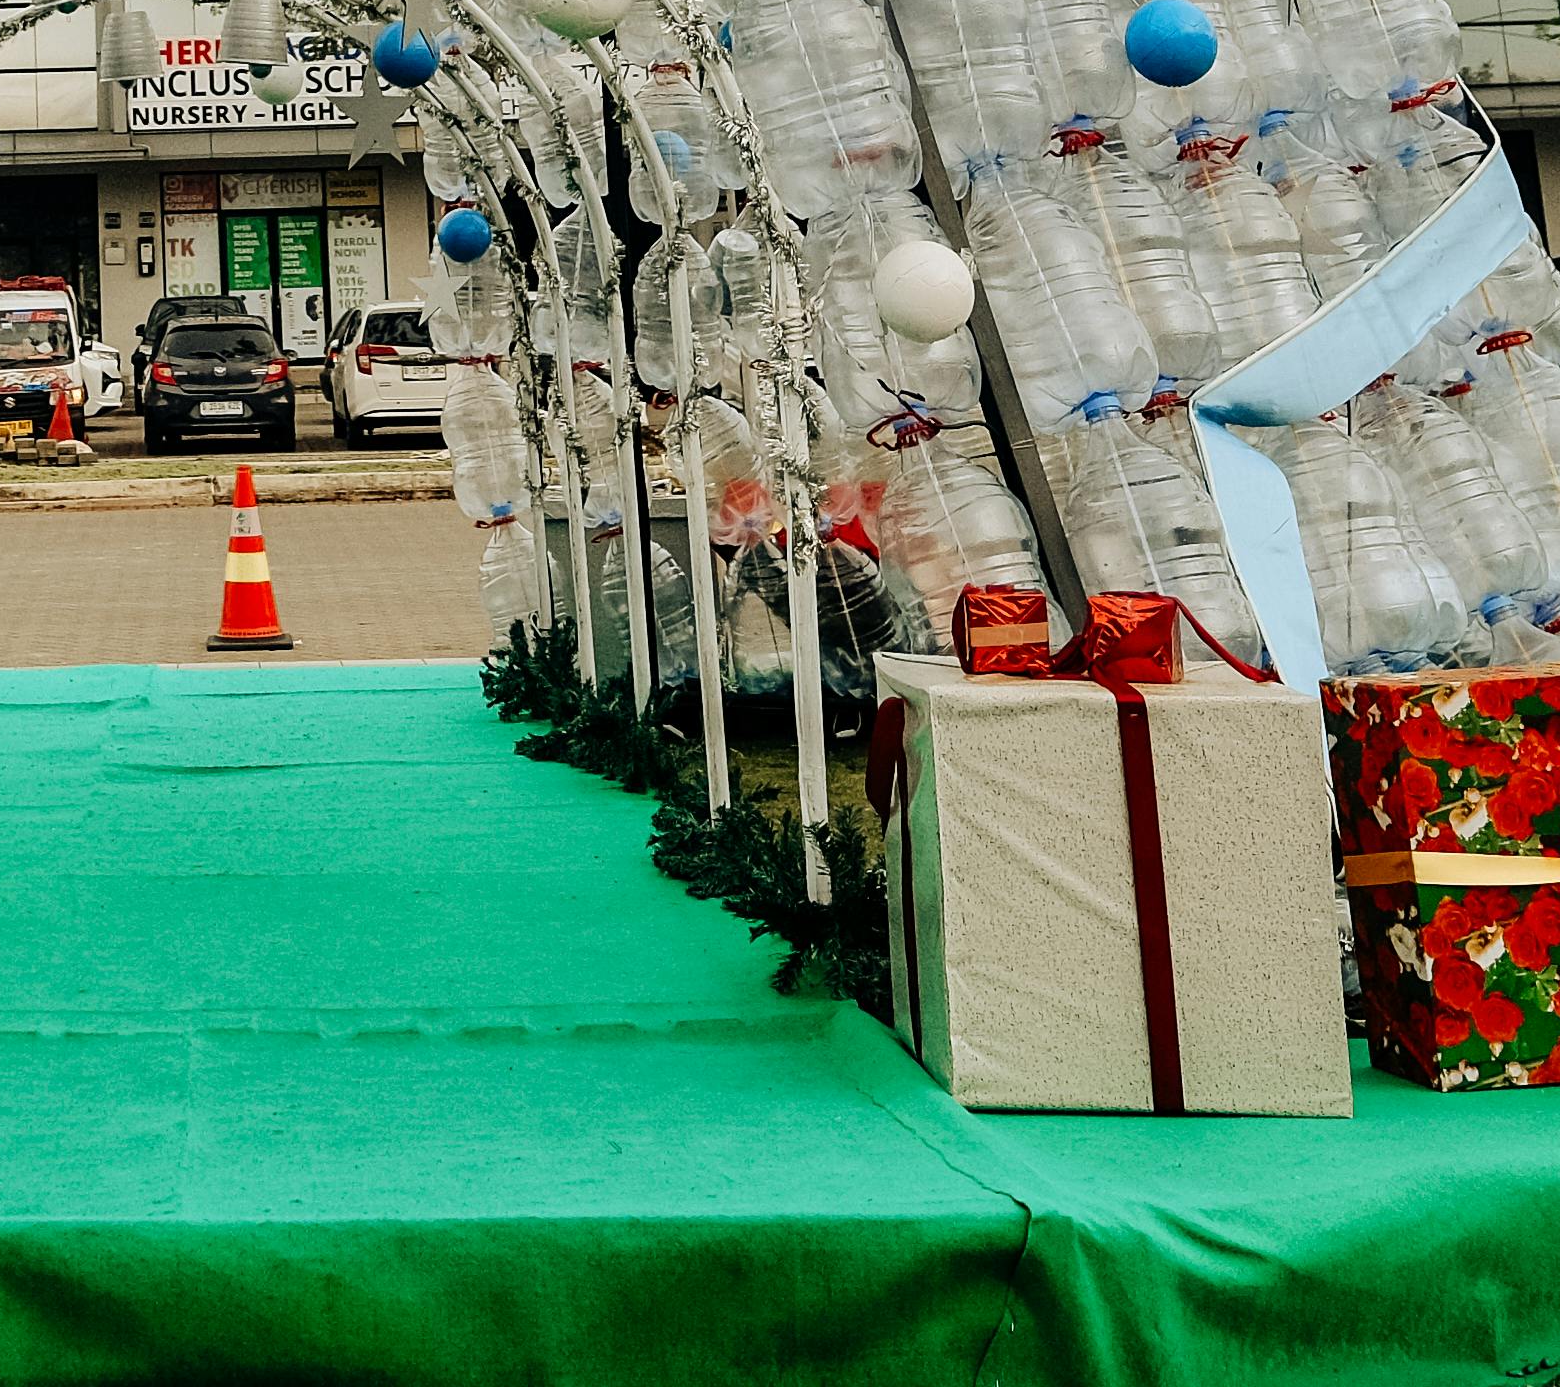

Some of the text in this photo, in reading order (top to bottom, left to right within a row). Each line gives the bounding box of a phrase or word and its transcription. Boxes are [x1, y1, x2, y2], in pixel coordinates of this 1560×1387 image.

[132, 104, 248, 126] NURSERY
[242, 177, 320, 196] CHERISH
[330, 189, 368, 199] SCHOOL
[333, 236, 378, 247] ENROLL
[166, 237, 196, 258] TK
[333, 248, 368, 258] NOW!
[168, 259, 195, 280] SD
[335, 264, 360, 275] WA:
[337, 287, 368, 297] 1777-
